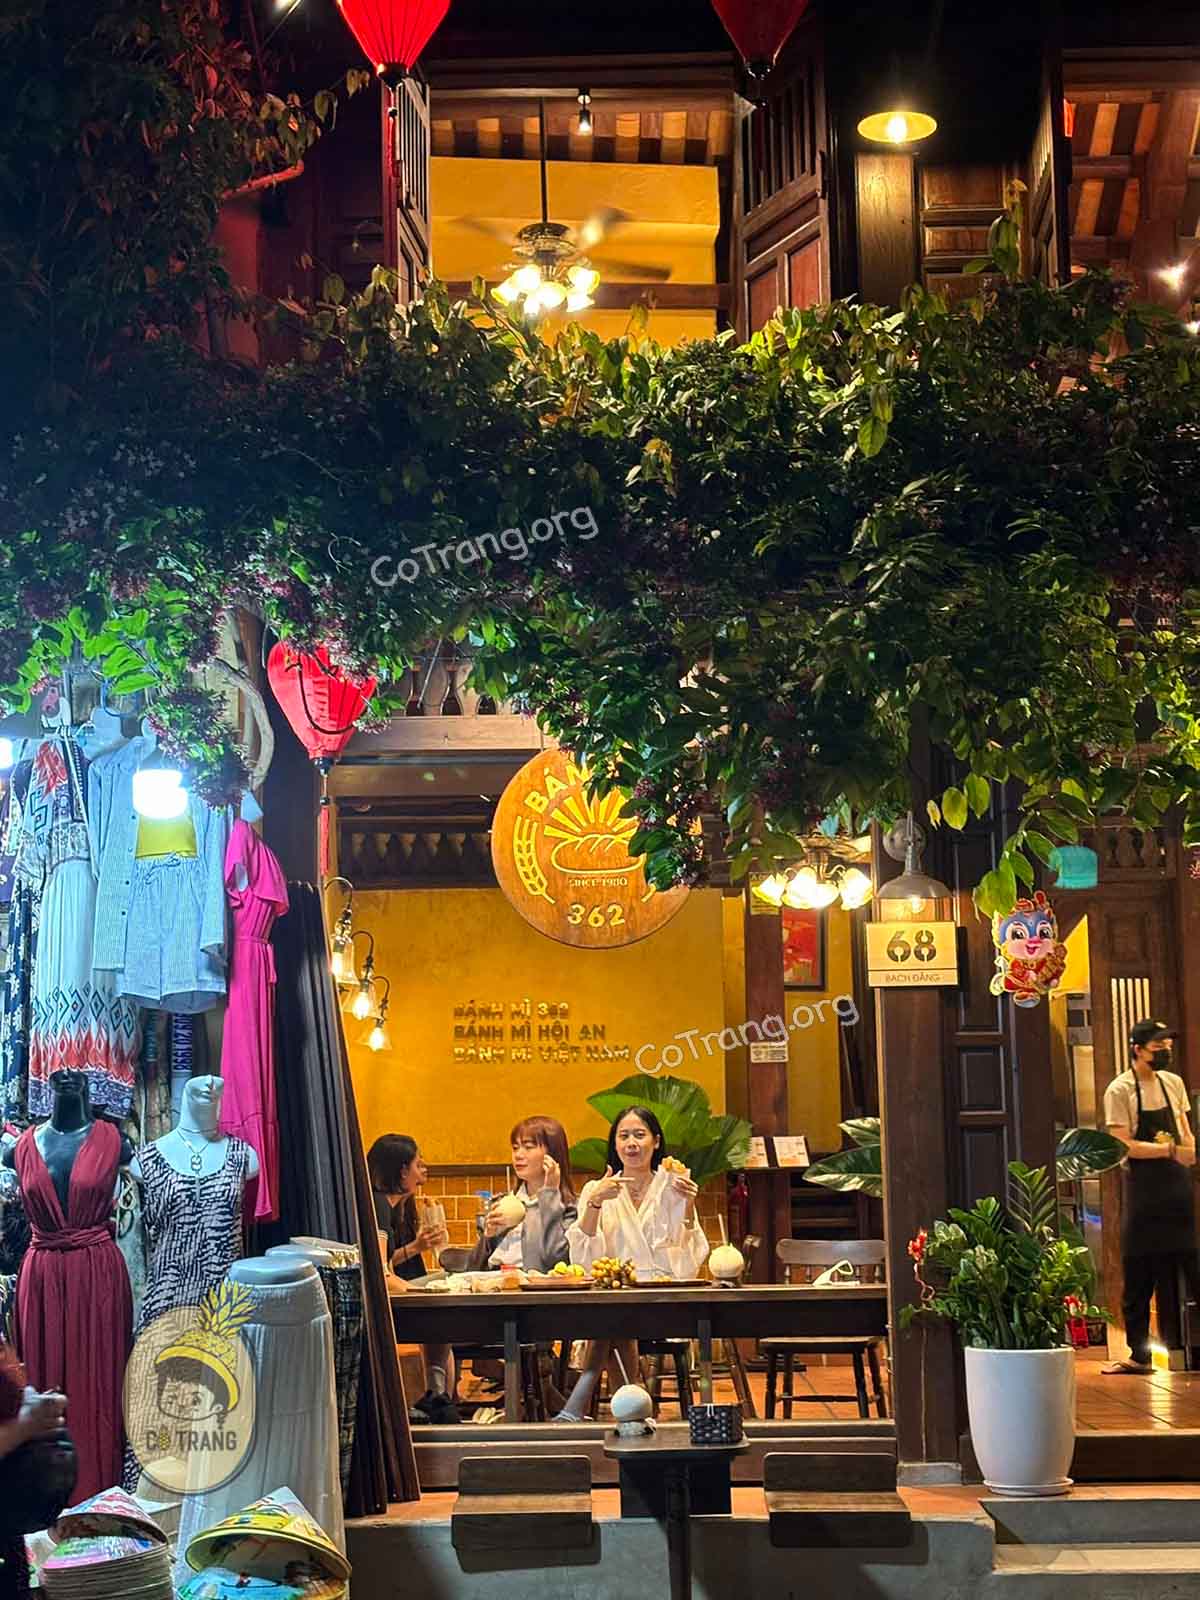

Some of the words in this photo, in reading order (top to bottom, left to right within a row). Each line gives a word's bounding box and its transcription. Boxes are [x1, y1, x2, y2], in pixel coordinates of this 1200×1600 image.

[524, 760, 592, 814] BÁN
[567, 903, 625, 928] 362
[886, 930, 937, 962] 68
[453, 1000, 504, 1020] BÁNH
[453, 1020, 504, 1042] BÁNH
[511, 1021, 532, 1041] MÌ
[578, 1023, 606, 1041] AN
[585, 1044, 630, 1063] NAM
